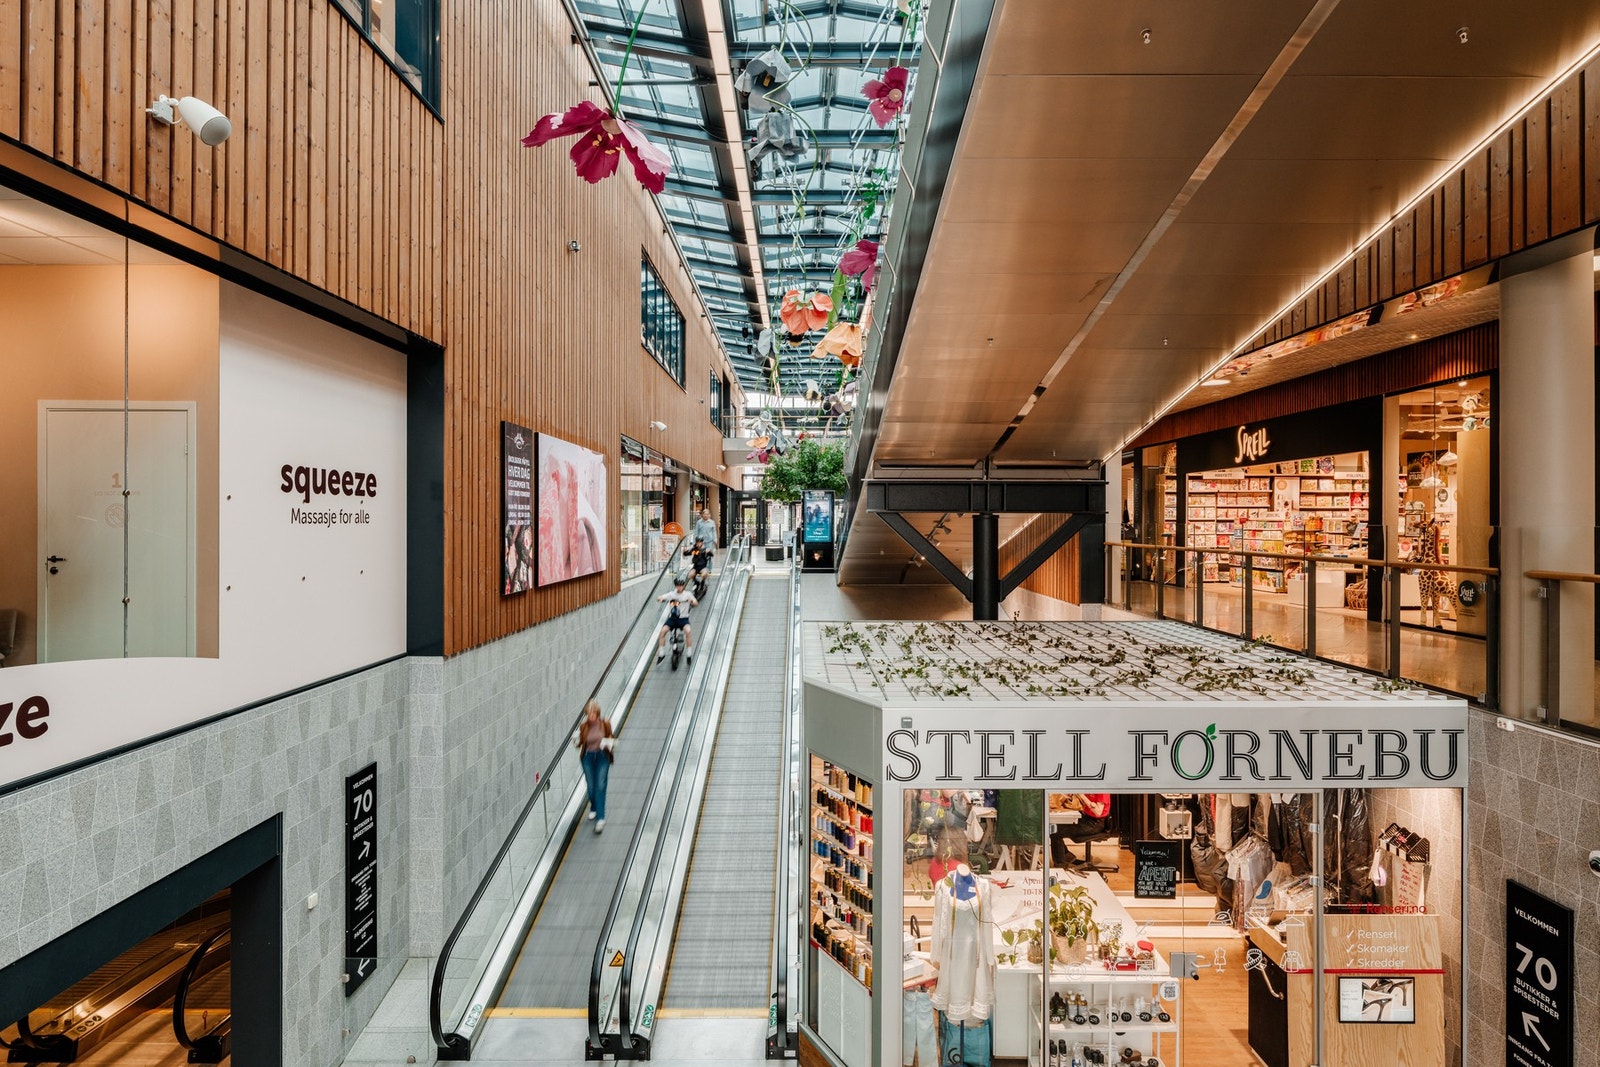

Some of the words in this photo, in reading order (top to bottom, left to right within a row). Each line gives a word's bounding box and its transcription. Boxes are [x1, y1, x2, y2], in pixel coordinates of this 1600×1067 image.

[281, 464, 377, 503] squeeze
[291, 507, 337, 528] Massasje
[339, 508, 352, 524] for
[354, 509, 370, 524] alle
[886, 729, 1107, 782] STELL
[1128, 728, 1465, 781] FORNEBU
[354, 789, 373, 820] 70
[1138, 865, 1176, 882] ÅPENT
[1366, 902, 1427, 914] Renseri.no
[1514, 907, 1559, 937] VELKOMMEN
[1357, 929, 1397, 939] Renseri
[1357, 944, 1410, 953] Skomaker
[1357, 958, 1406, 967] Skredder
[1515, 941, 1558, 991] 70
[1513, 985, 1560, 1020] SPISESTEDER
[1516, 977, 1550, 1005] BUTIKKER
[1551, 1000, 1557, 1009] &
[1508, 1034, 1534, 1057] INNGANG
[1534, 1053, 1546, 1067] FRA
